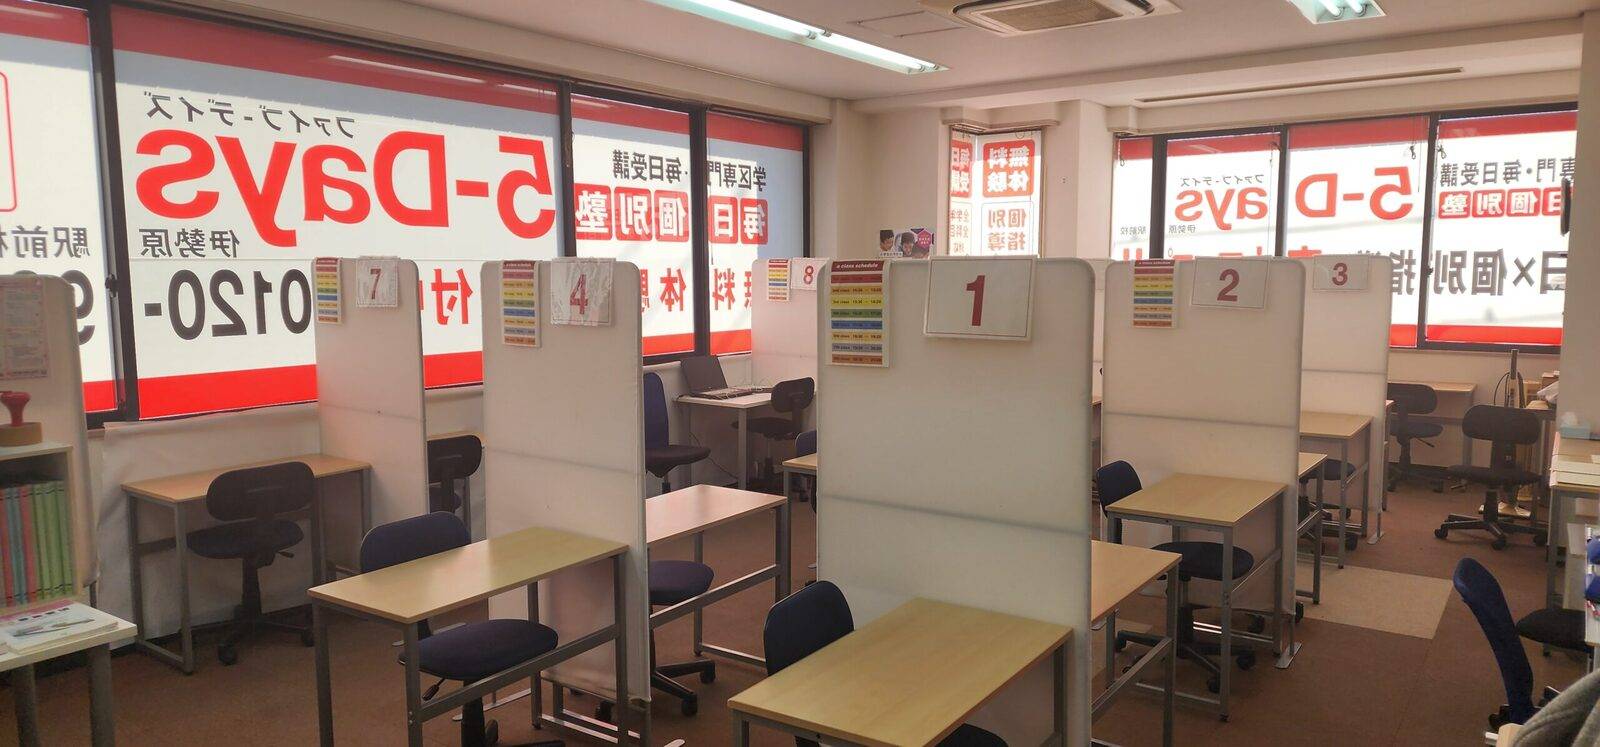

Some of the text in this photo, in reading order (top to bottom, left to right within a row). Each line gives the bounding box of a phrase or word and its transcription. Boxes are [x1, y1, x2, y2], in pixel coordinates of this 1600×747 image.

[370, 268, 382, 300] 7
[802, 265, 814, 285] 8
[1216, 269, 1240, 303] 2
[1331, 262, 1349, 287] 3
[569, 273, 588, 315] 4
[965, 274, 988, 327] 1
